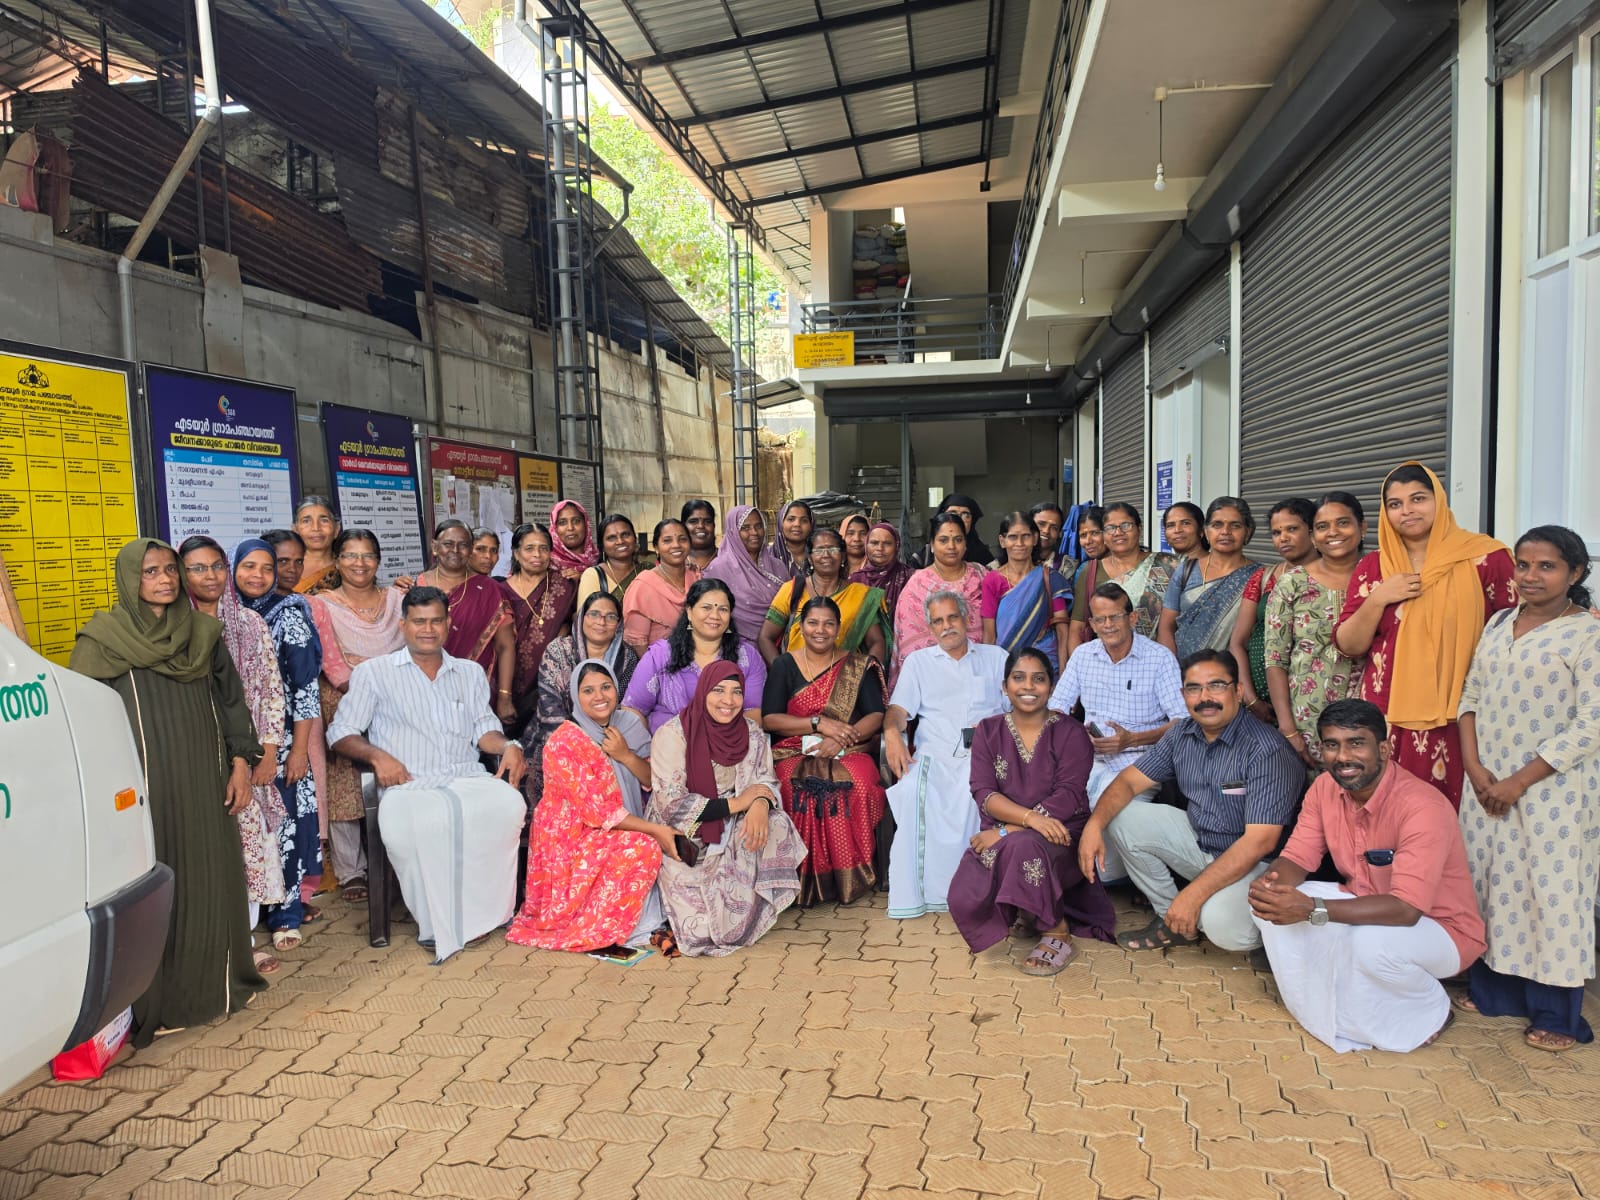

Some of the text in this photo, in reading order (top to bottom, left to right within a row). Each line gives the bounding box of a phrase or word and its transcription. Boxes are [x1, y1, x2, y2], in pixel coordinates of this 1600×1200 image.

[174, 417, 275, 440] എടയൂർ ഗ്രാമപഞ്ചായത്ത്
[0, 673, 48, 722] ത്ത്
